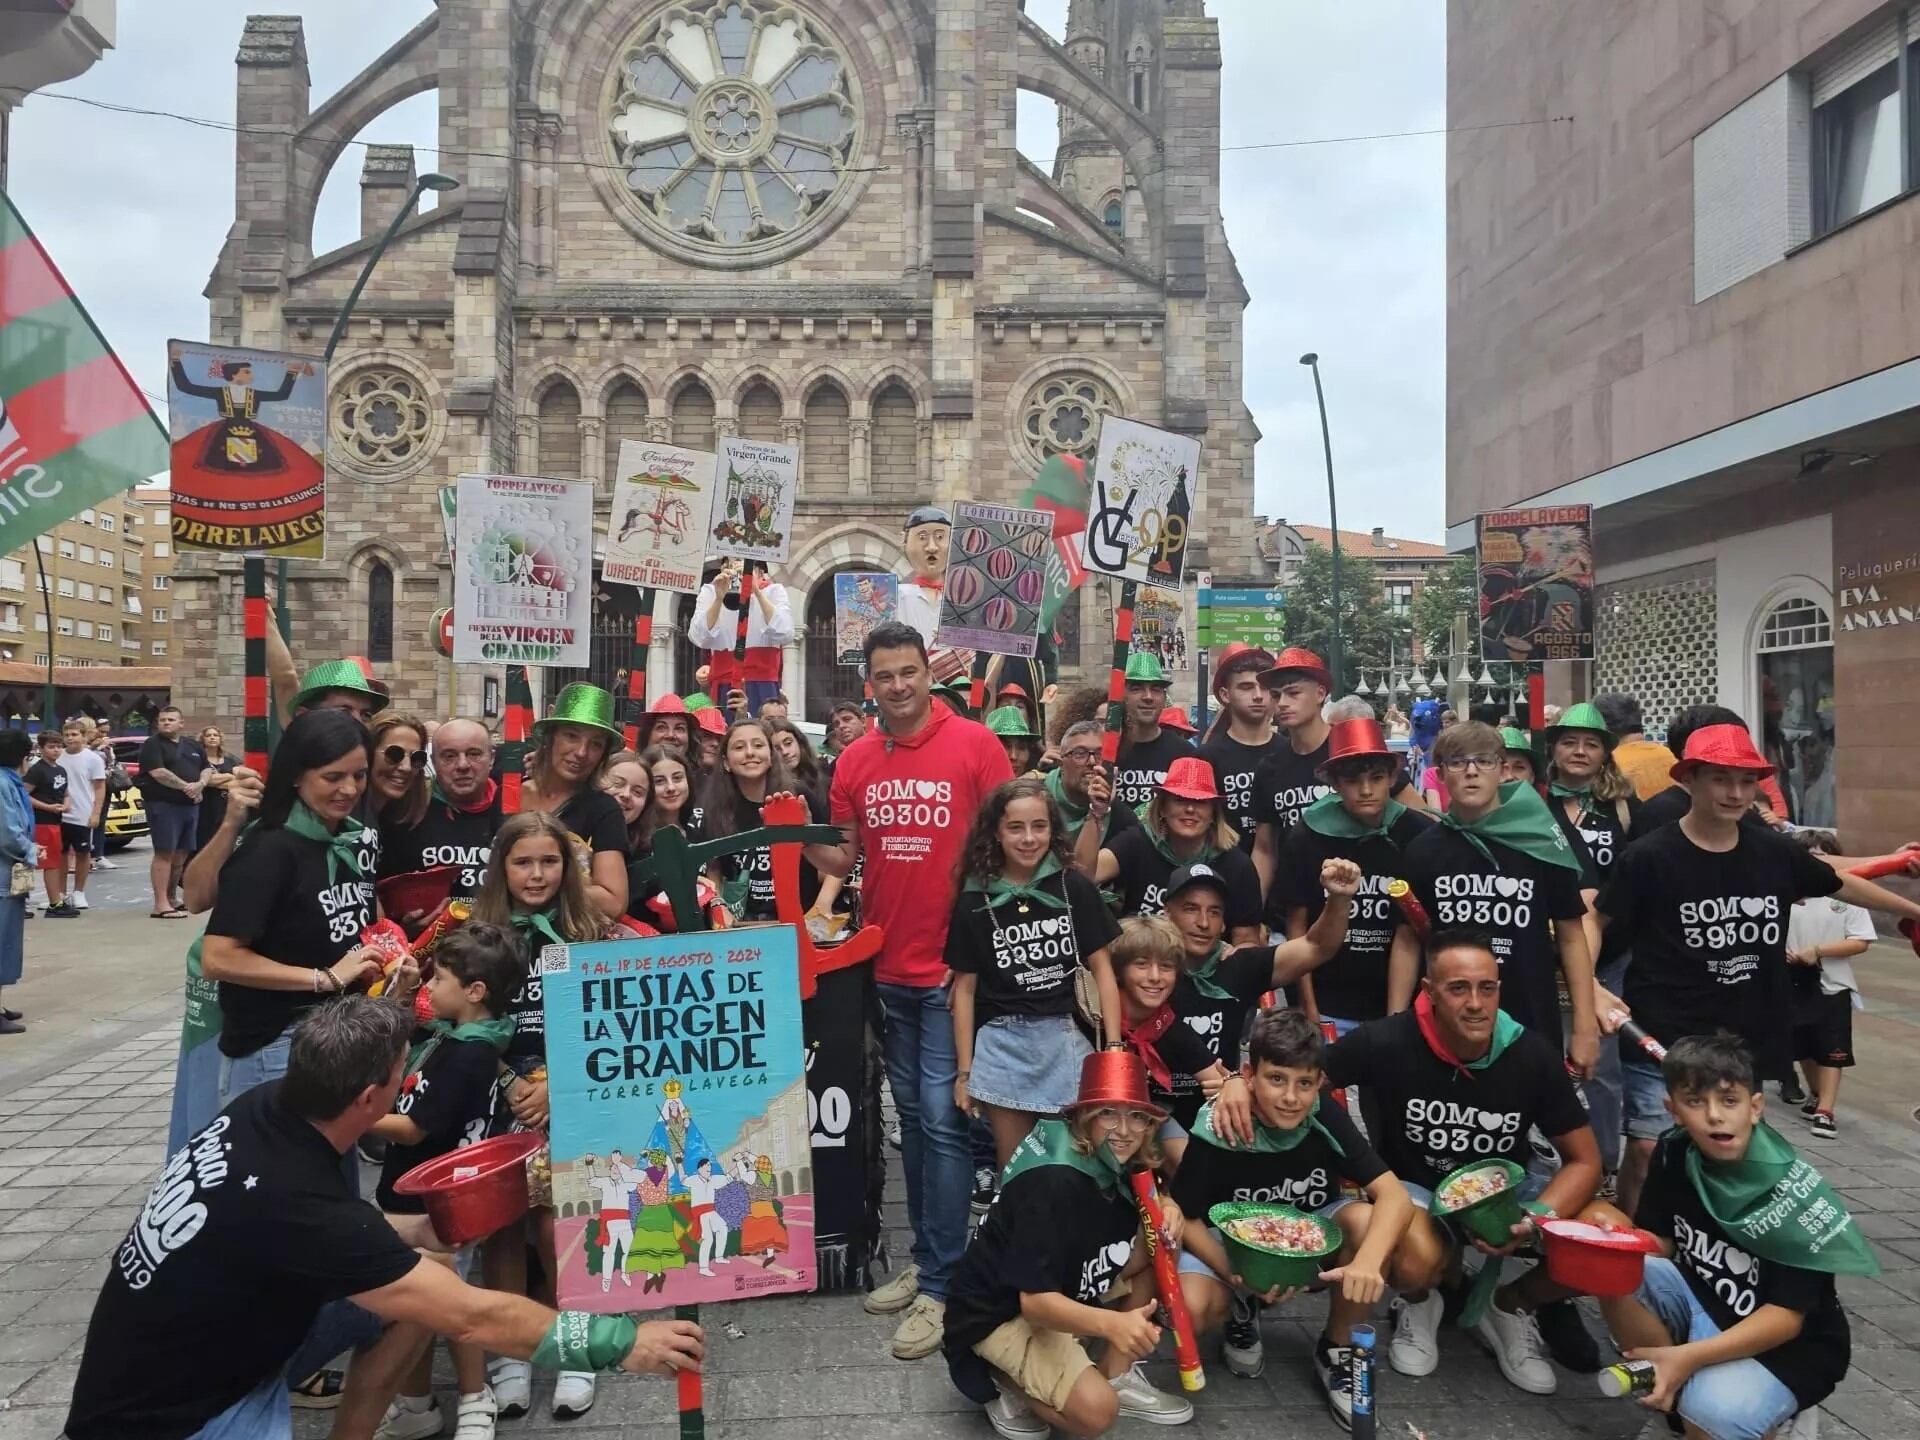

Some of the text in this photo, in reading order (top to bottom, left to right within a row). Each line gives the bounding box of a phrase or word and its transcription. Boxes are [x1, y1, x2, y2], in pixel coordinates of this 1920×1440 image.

[726, 447, 792, 465] Virgen Grande
[486, 479, 568, 495] TORRELAVEGA
[963, 505, 1047, 526] TORRELAVEGA
[1486, 507, 1586, 527] TORRELAVEGA
[606, 562, 697, 590] VIRGEN GRANDE
[1839, 553, 1920, 581] Peluquerí
[1840, 584, 1881, 608] EVA
[468, 624, 501, 633] FIESTAS
[502, 625, 576, 645] VIRGEN
[1534, 632, 1592, 645] AGOSTO
[481, 642, 562, 661] GRANDE
[1016, 642, 1032, 656] 1963
[1546, 646, 1580, 659] 1966
[866, 803, 951, 829] 39300
[1437, 900, 1531, 928] 39300
[1683, 921, 1780, 949] 39300
[581, 947, 762, 976] 9 AL 18 DE AGOSTO 2024
[995, 936, 1074, 969] 39300
[582, 968, 715, 1013] FIESTAS
[727, 970, 763, 995] DE
[583, 998, 766, 1044] LA VIRGEN
[585, 1032, 767, 1084] GRANDE
[1404, 1122, 1516, 1154] 39300
[1741, 1196, 1798, 1240] Virgen
[1353, 1357, 1362, 1407] POWDER
